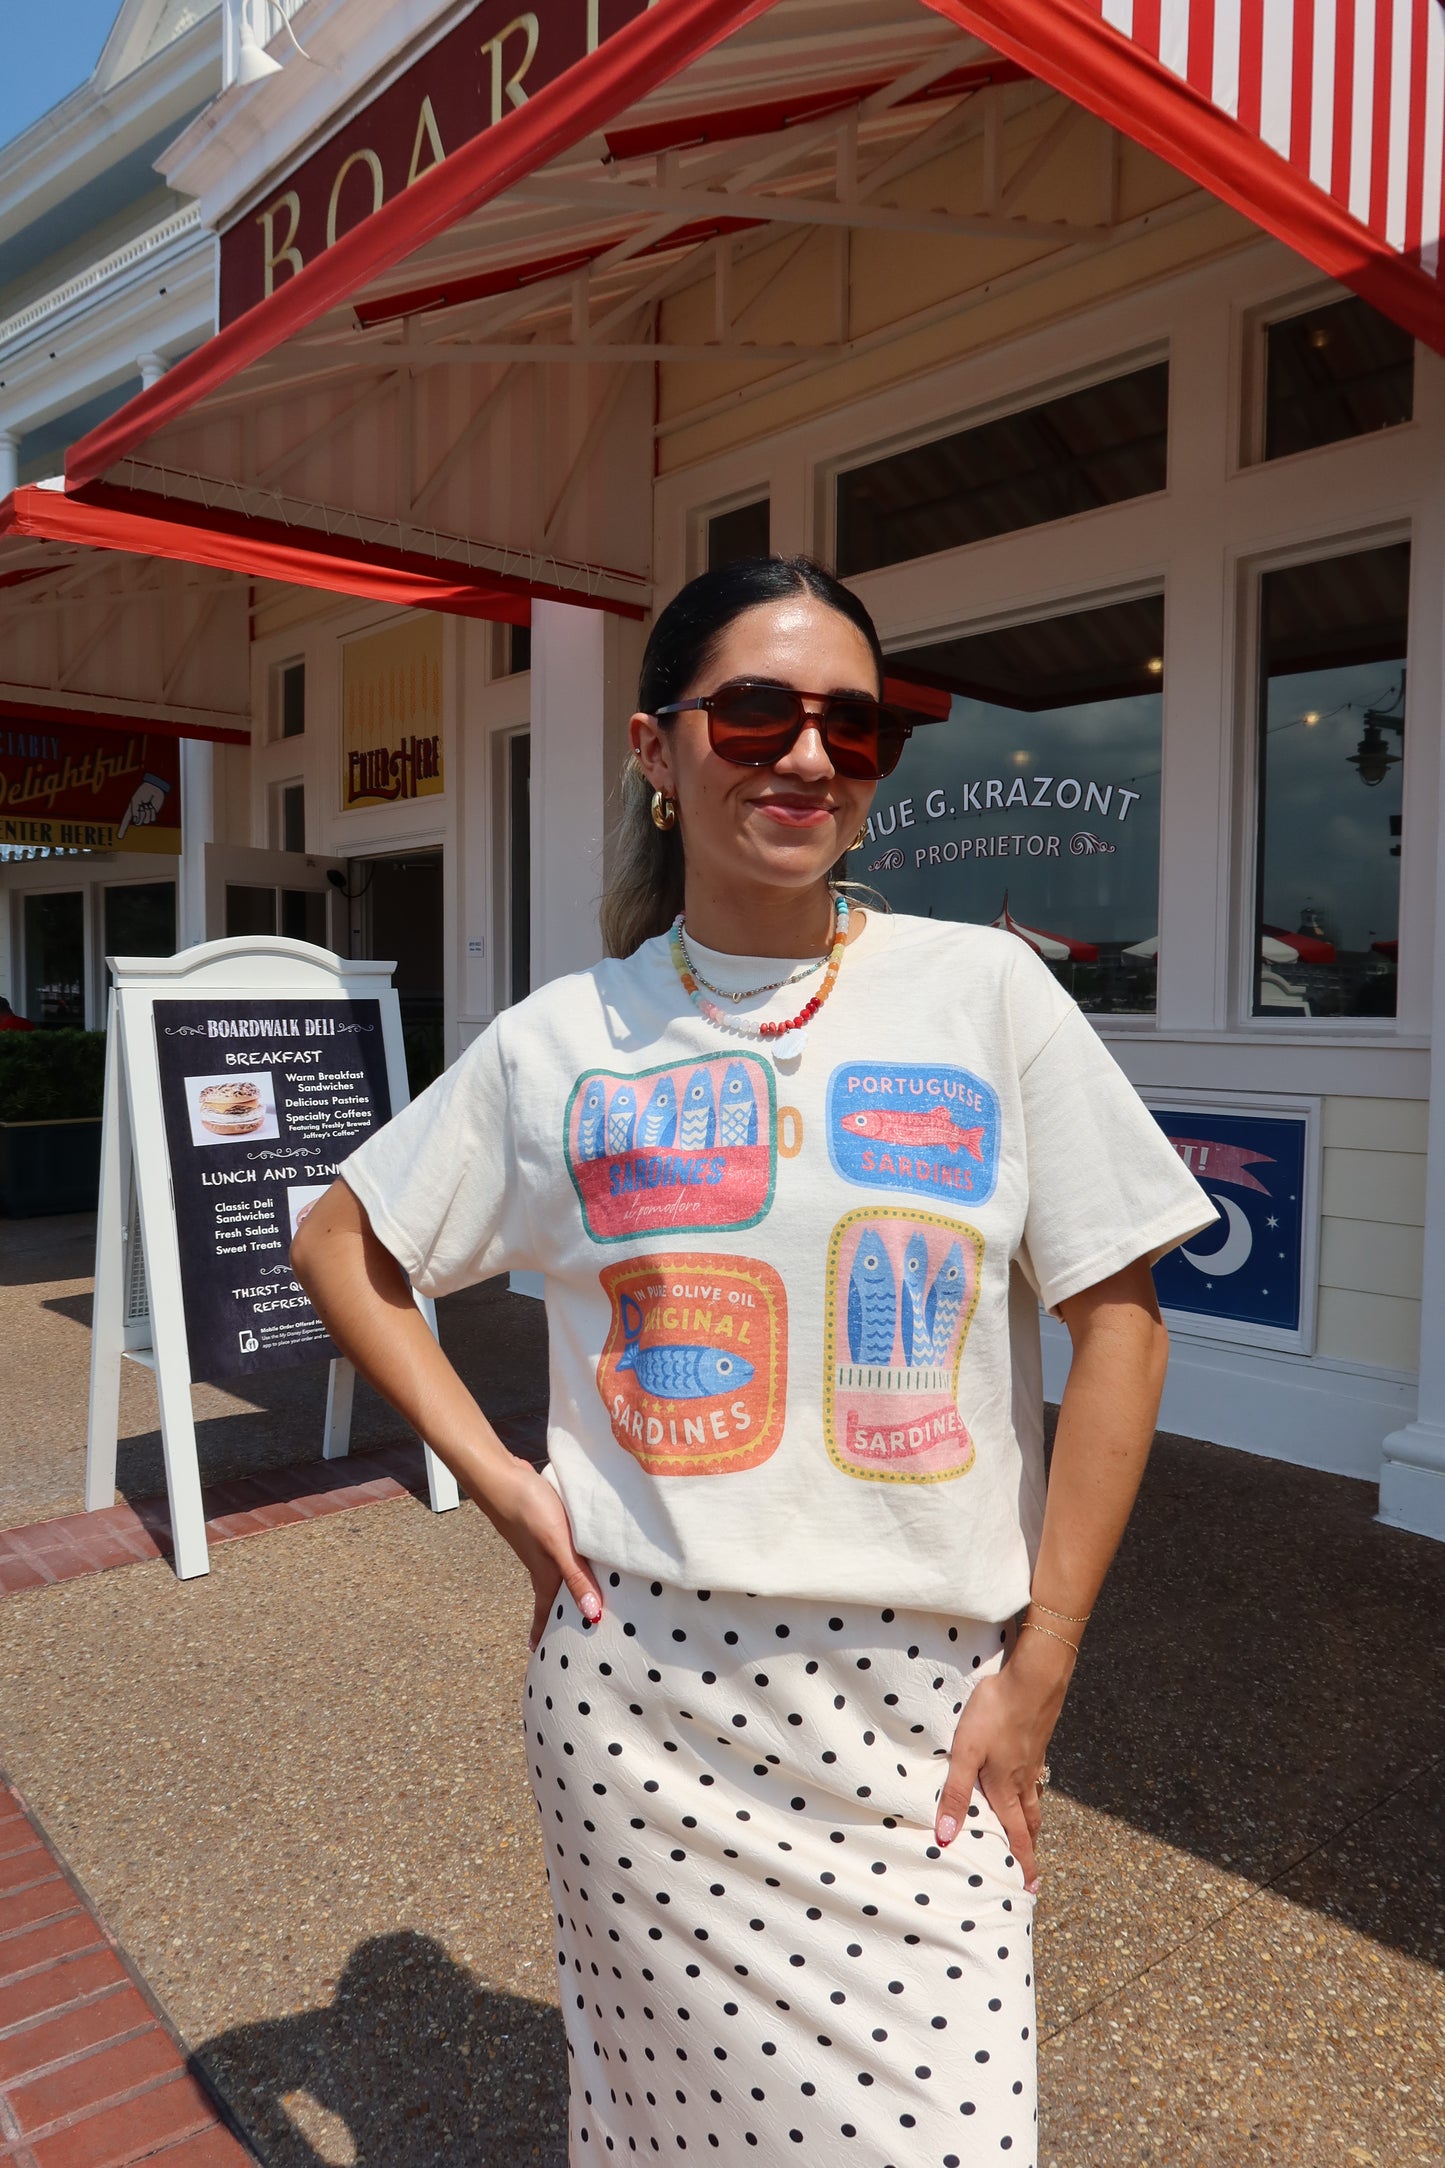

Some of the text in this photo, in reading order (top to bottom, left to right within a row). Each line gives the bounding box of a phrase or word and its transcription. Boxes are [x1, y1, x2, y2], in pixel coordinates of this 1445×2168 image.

[256, 0, 661, 298] BOAR
[0, 728, 60, 760] TABLY
[390, 736, 439, 799] HERE
[925, 789, 955, 819] G.
[963, 777, 1141, 822] KRAZONT
[61, 824, 113, 846] HERE!
[915, 834, 1061, 868] PROPRIETOR
[207, 1018, 335, 1038] BOARDWALK DELI
[225, 1050, 323, 1066] BREAKFAST
[285, 1070, 364, 1082] Warm Breakfast
[297, 1082, 354, 1092] Sandwiches
[847, 1076, 983, 1113] PORTUGUESE
[285, 1095, 369, 1107] Delicious Pastries
[285, 1109, 372, 1124] Specialty Coffees
[321, 1122, 345, 1130] Freshly
[201, 1169, 257, 1186] LUNCH
[263, 1167, 298, 1181] AND
[609, 1155, 727, 1198] SARDINES
[862, 1150, 974, 1192] SARDINES
[214, 1199, 274, 1213] Classic Deli
[216, 1211, 275, 1224] Sandwiches
[214, 1225, 279, 1240] Fresh Salads
[216, 1240, 282, 1255] Sweet Treats
[634, 1284, 756, 1308] IN PURE OLIVE OIL
[611, 1394, 751, 1445] SARDINES
